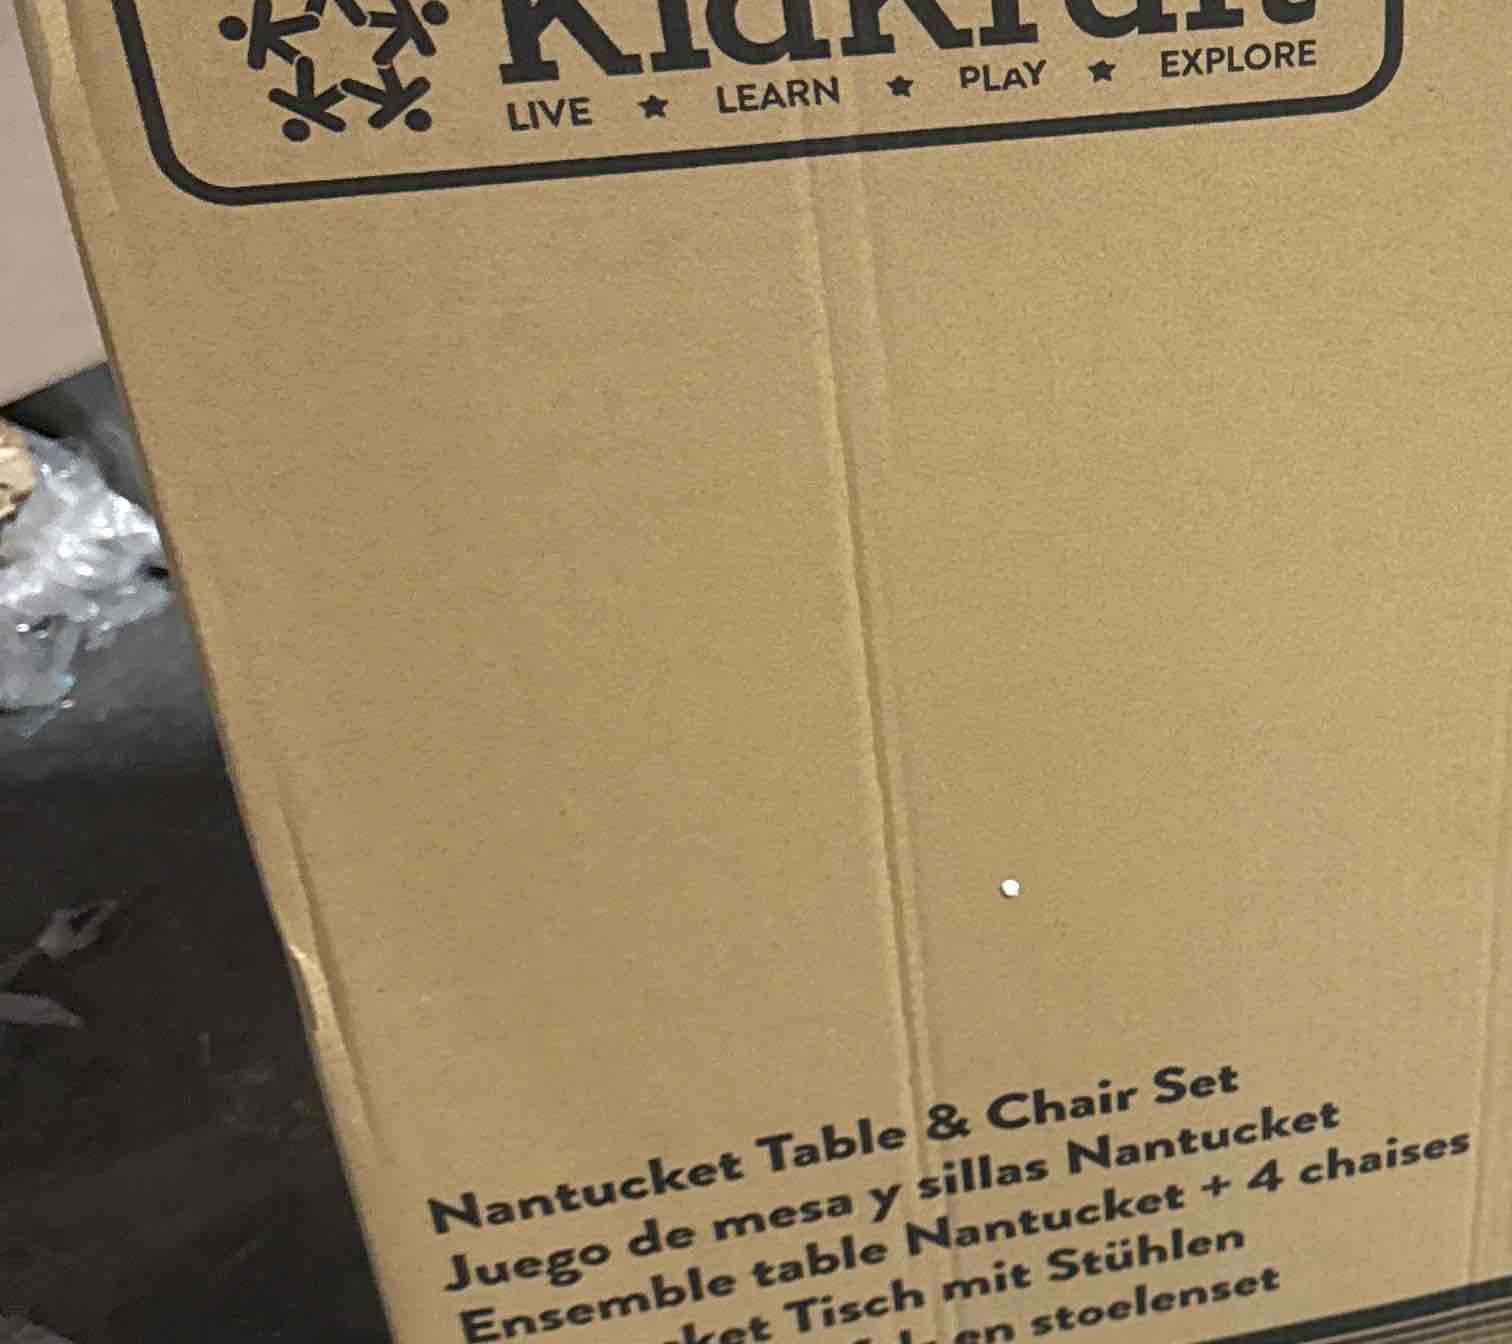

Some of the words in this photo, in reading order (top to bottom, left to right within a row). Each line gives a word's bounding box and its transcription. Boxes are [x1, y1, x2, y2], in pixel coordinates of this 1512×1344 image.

[506, 94, 594, 133] LIVE
[716, 74, 842, 116] LEARN
[960, 60, 1048, 94] PLAY
[1160, 39, 1317, 78] EXPLORE
[428, 1151, 744, 1235] Nantucket
[754, 1118, 908, 1174] Table
[926, 1102, 971, 1141] &
[987, 1080, 1139, 1132] Chair
[1153, 1064, 1239, 1105] Set
[444, 1241, 611, 1294] Juego
[628, 1219, 696, 1257] de
[712, 1193, 853, 1241] mesa
[869, 1183, 903, 1224] y
[917, 1154, 1050, 1200] sillas
[1066, 1100, 1341, 1175] Nantucket
[751, 1235, 889, 1289] table
[905, 1183, 1185, 1257] Nantucket
[1201, 1173, 1232, 1199] +
[1246, 1158, 1285, 1194] 4
[1299, 1129, 1471, 1186] chaises
[782, 1277, 925, 1335] Tisch
[942, 1259, 1032, 1303] mit
[1047, 1226, 1246, 1283] Stühlen
[1031, 1267, 1281, 1339] stoelenset
